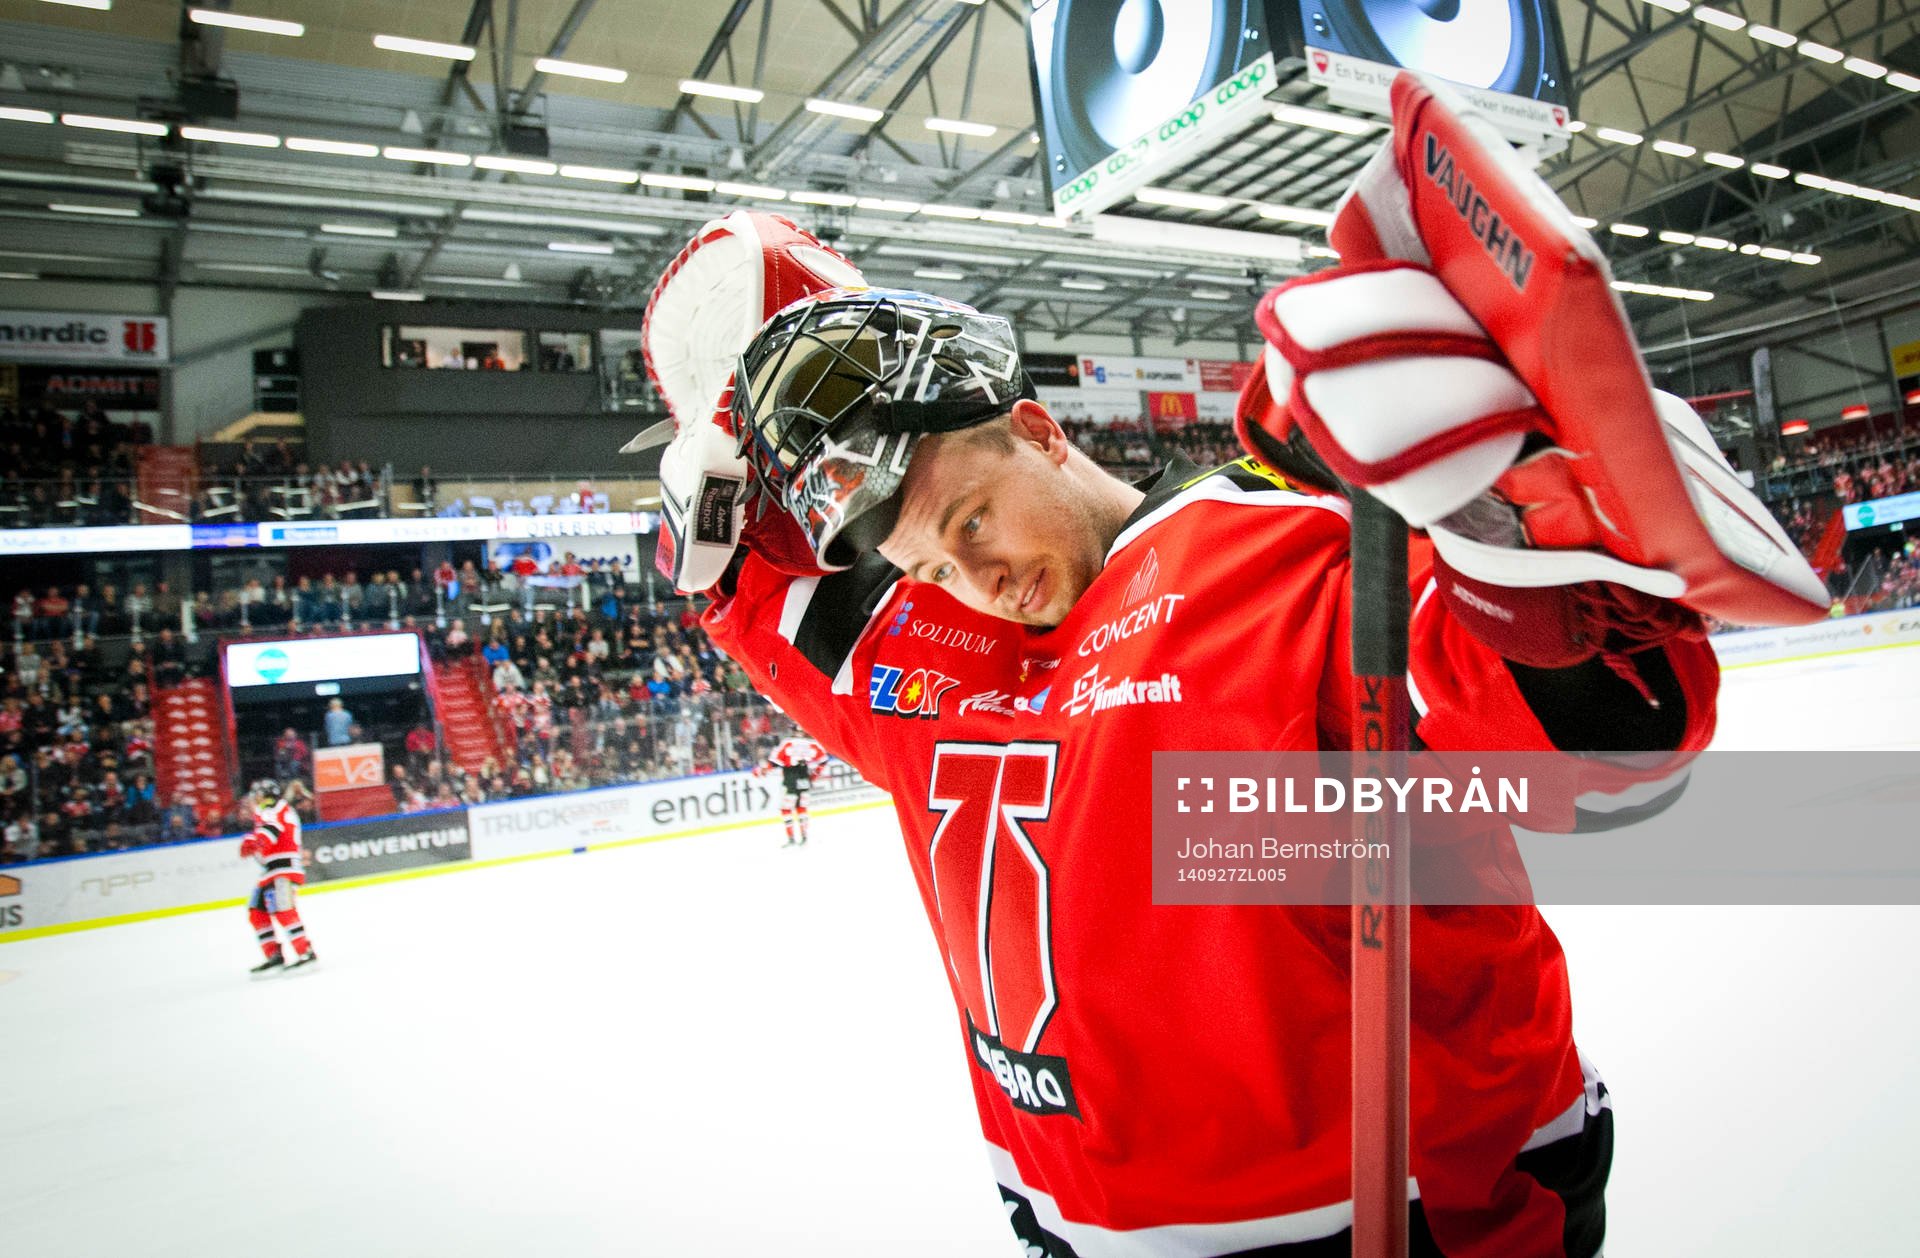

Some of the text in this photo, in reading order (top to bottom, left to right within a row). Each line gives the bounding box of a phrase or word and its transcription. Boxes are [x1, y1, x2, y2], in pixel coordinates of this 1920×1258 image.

[1216, 62, 1267, 106] coop
[1158, 103, 1206, 143] coop
[1058, 171, 1099, 206] coop
[1422, 131, 1536, 294] VAUGHN
[702, 487, 720, 530] Reebok
[908, 618, 998, 656] SOLIDUM
[1078, 592, 1185, 658] CONCENT
[1359, 676, 1386, 950] Reebok
[314, 825, 468, 865] CONVENTUM
